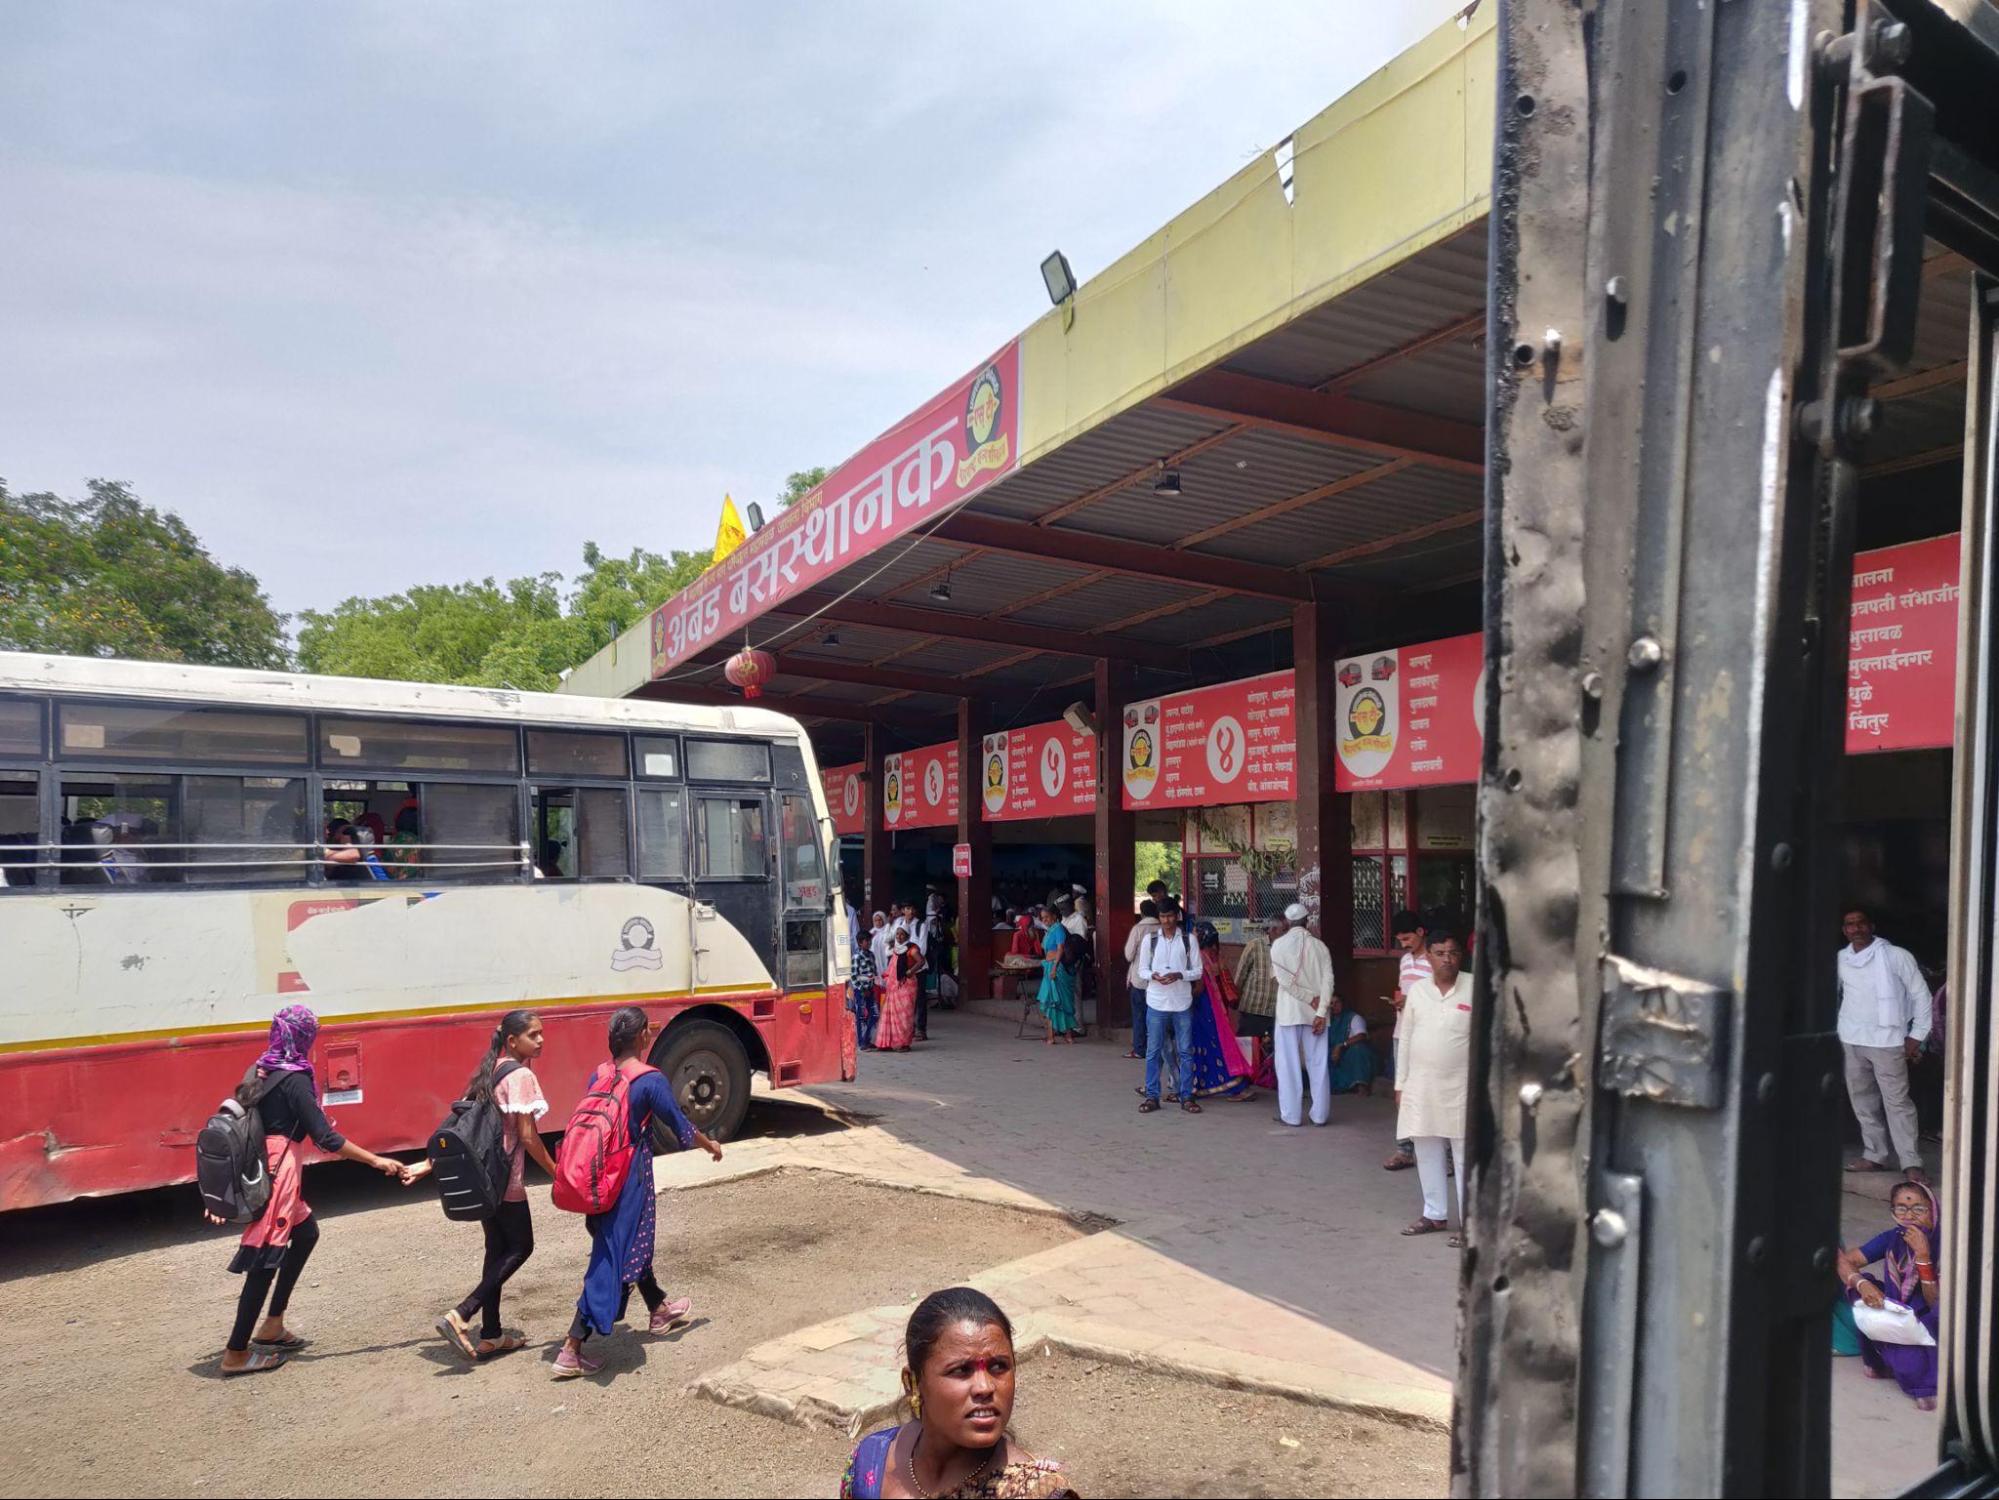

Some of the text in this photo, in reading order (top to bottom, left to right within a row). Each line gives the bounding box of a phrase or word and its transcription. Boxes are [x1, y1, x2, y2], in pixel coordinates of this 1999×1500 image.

[801, 490, 824, 518] विभाग
[668, 416, 959, 658] अंबड बसस्थानक
[1848, 649, 1933, 679] मुक्ताईनगर
[1848, 681, 1872, 708] धुळे
[1216, 726, 1235, 773] ४
